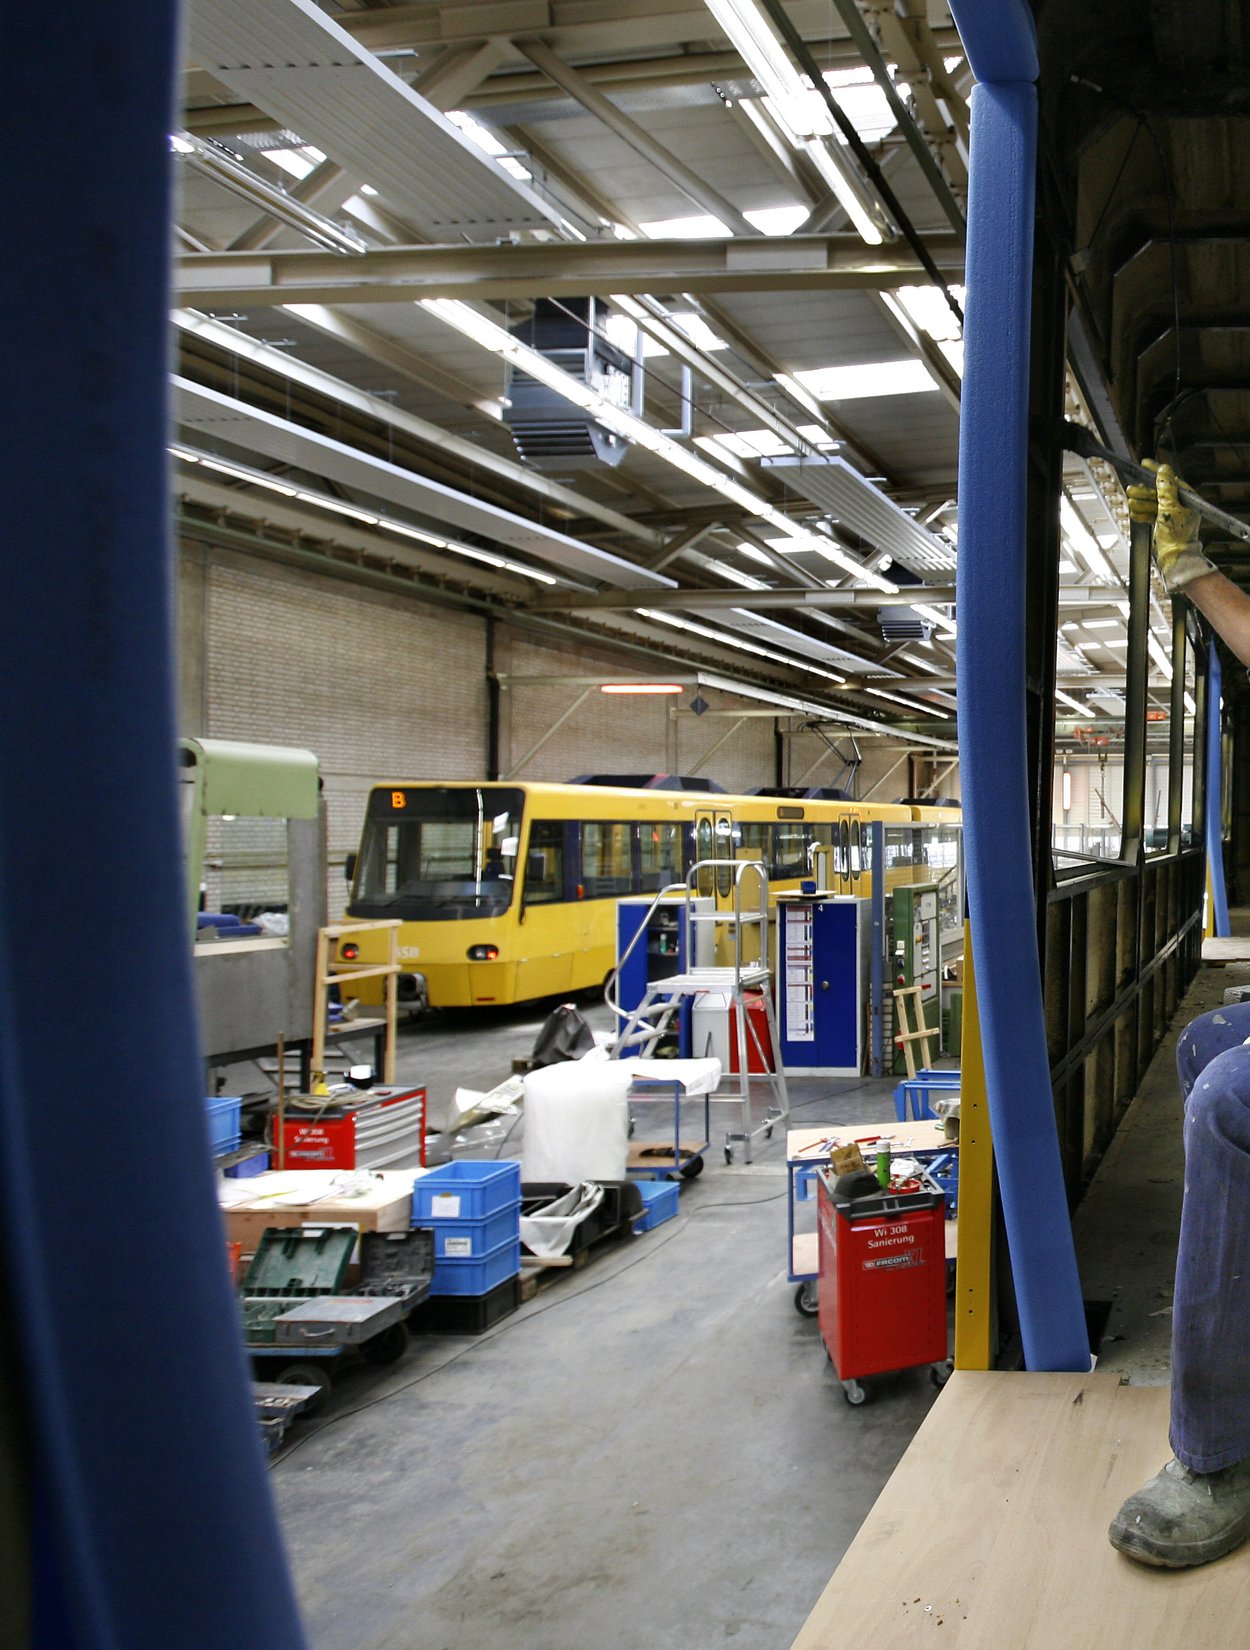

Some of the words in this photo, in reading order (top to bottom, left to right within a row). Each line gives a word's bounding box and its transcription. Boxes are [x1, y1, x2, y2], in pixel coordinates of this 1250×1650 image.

[391, 791, 407, 809] B
[874, 1228, 888, 1238] Wi
[889, 1225, 908, 1236] 308
[867, 1235, 915, 1249] Sanierung
